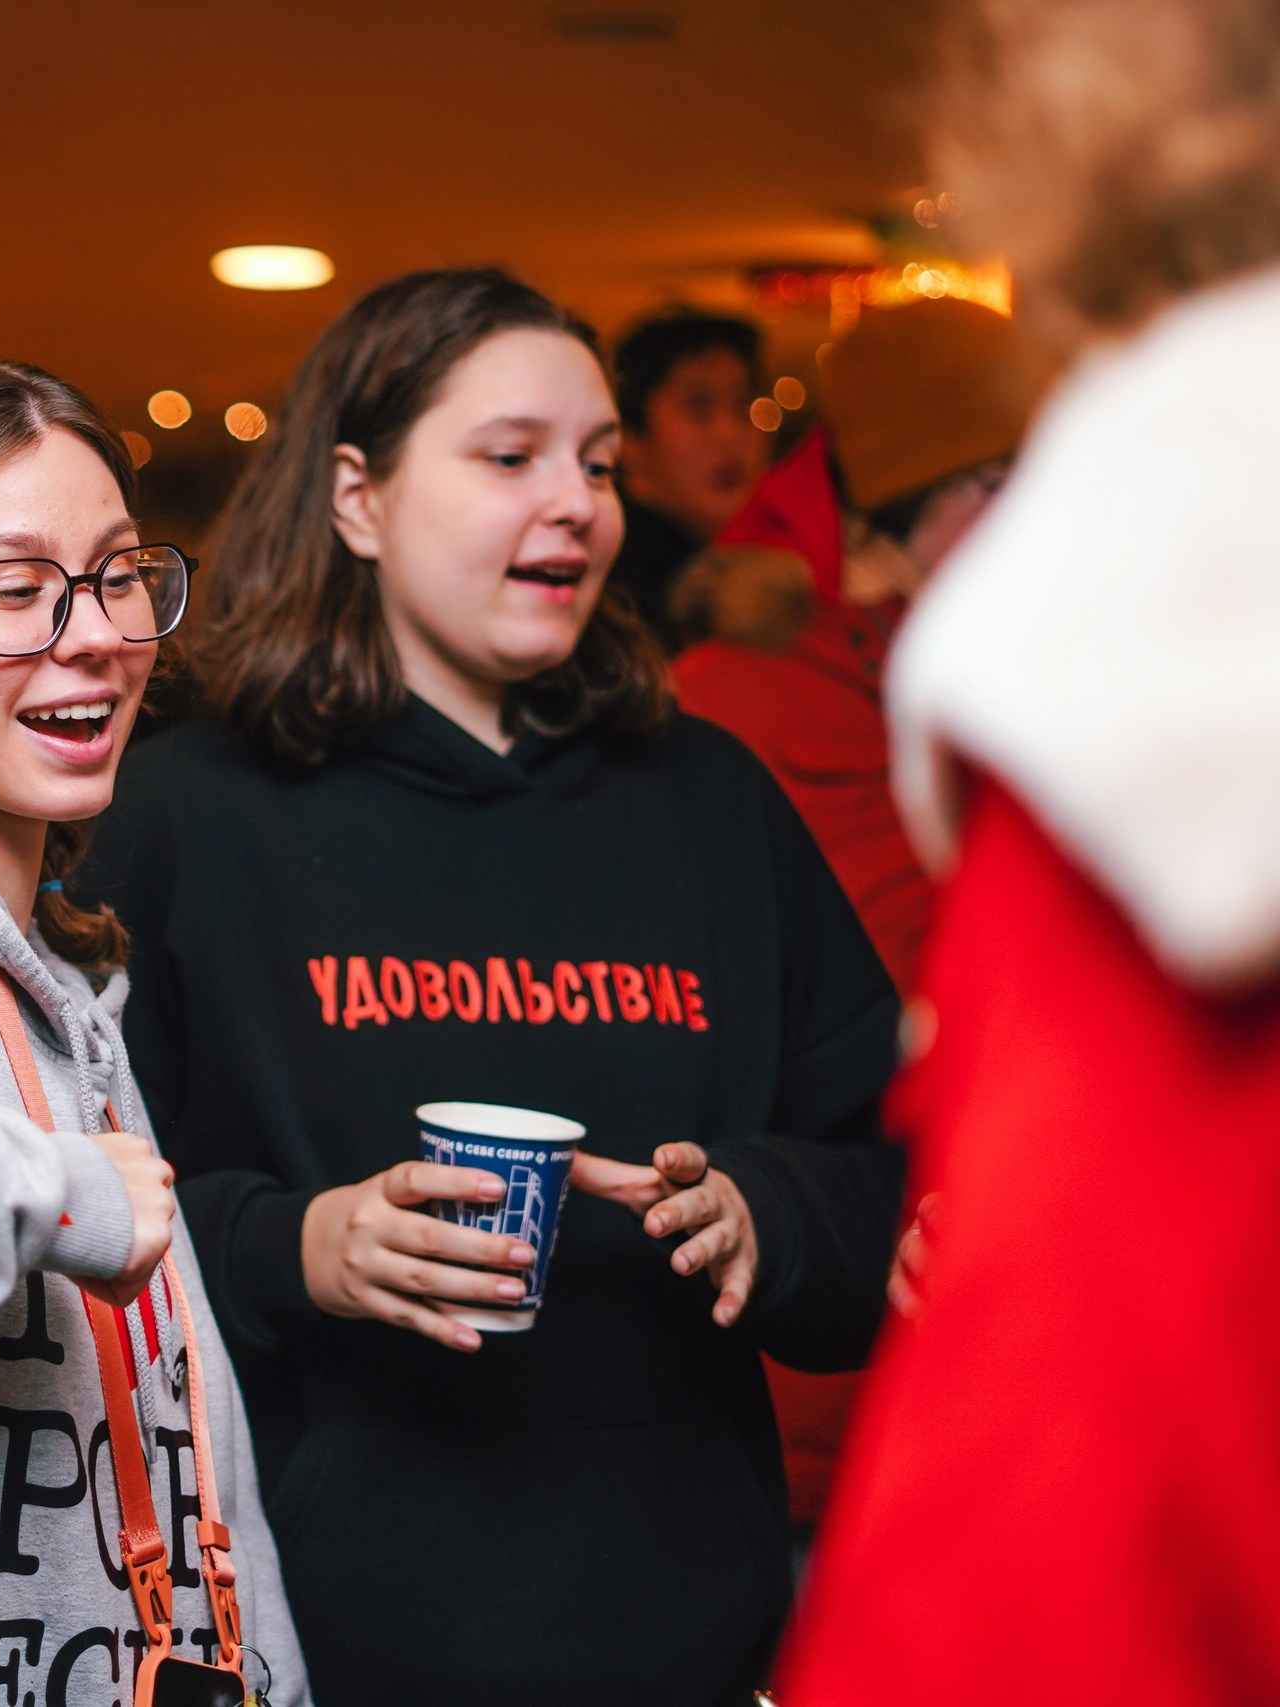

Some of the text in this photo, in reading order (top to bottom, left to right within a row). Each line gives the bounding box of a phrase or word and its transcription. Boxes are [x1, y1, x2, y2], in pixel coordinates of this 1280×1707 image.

[308, 954, 710, 1033] УДОВОЛЬСТВИЕ
[455, 1141, 464, 1153] В
[464, 1143, 496, 1158] СЕБЕ
[496, 1148, 535, 1161] СЕВЕР
